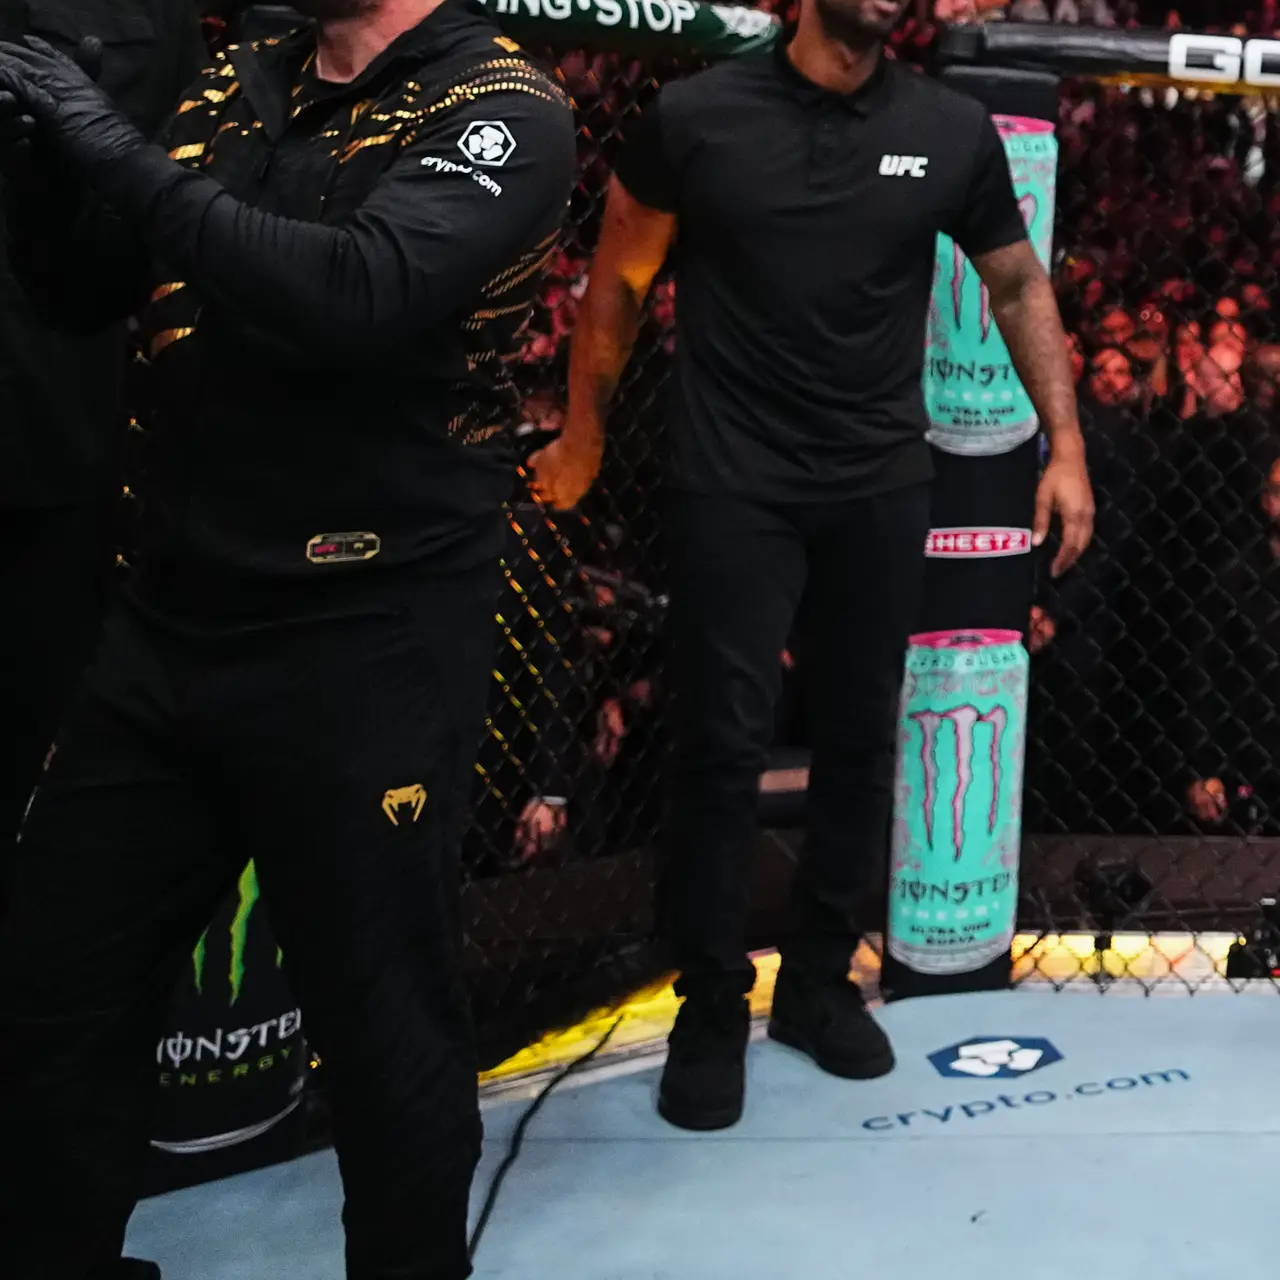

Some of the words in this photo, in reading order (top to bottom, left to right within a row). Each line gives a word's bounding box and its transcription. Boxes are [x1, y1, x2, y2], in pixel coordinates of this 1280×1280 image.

[878, 153, 929, 179] UFC
[158, 1046, 293, 1088] ENERGY
[860, 1066, 1192, 1133] crypto.com
